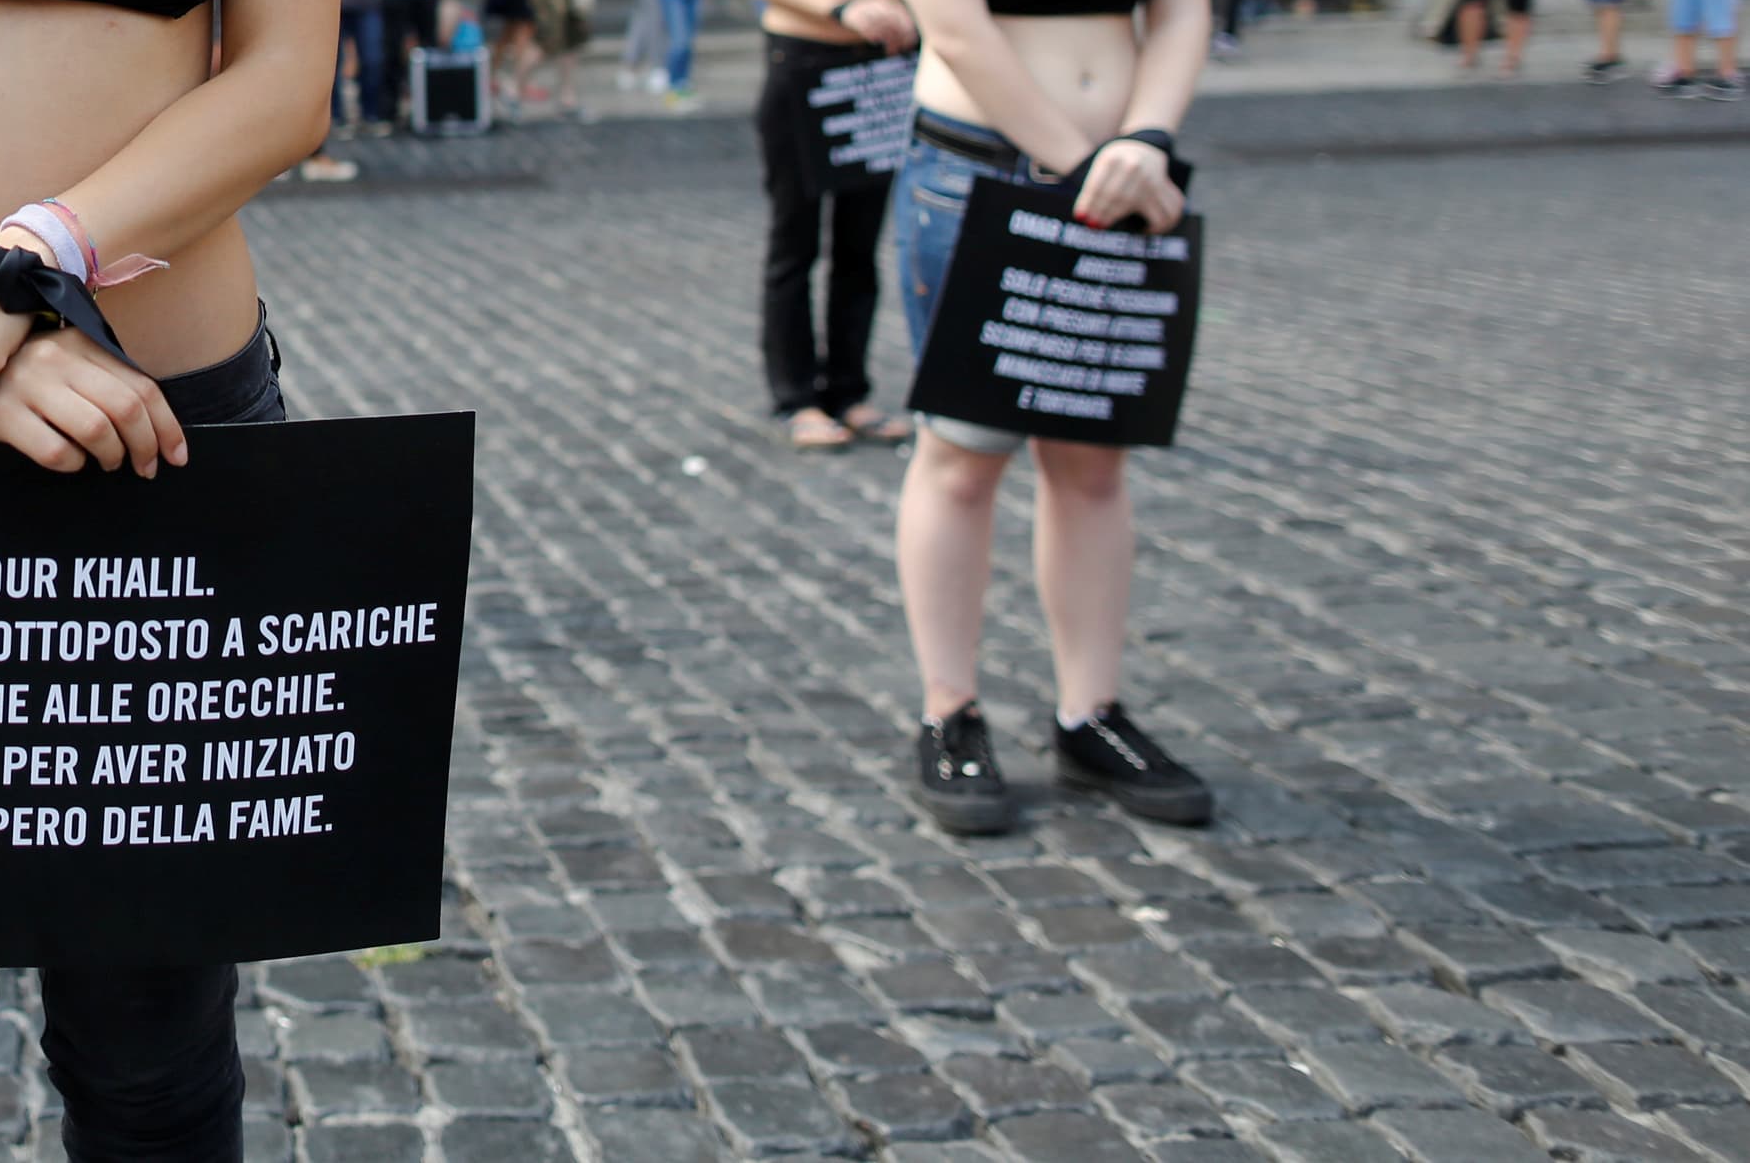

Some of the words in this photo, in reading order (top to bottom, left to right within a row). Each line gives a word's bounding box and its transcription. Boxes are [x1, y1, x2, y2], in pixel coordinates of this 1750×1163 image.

[1000, 266, 1048, 298] SOLO
[73, 556, 215, 598] KHALIL.
[221, 617, 245, 658] A
[257, 602, 438, 656] SCARICHE
[41, 683, 133, 724] ALLE
[147, 672, 345, 723] ORECCHIE.
[2, 746, 79, 785] PER
[91, 743, 187, 785] AVER
[202, 731, 356, 781] INIZIATO
[102, 803, 215, 846] DELLA
[228, 794, 333, 840] FAME.
